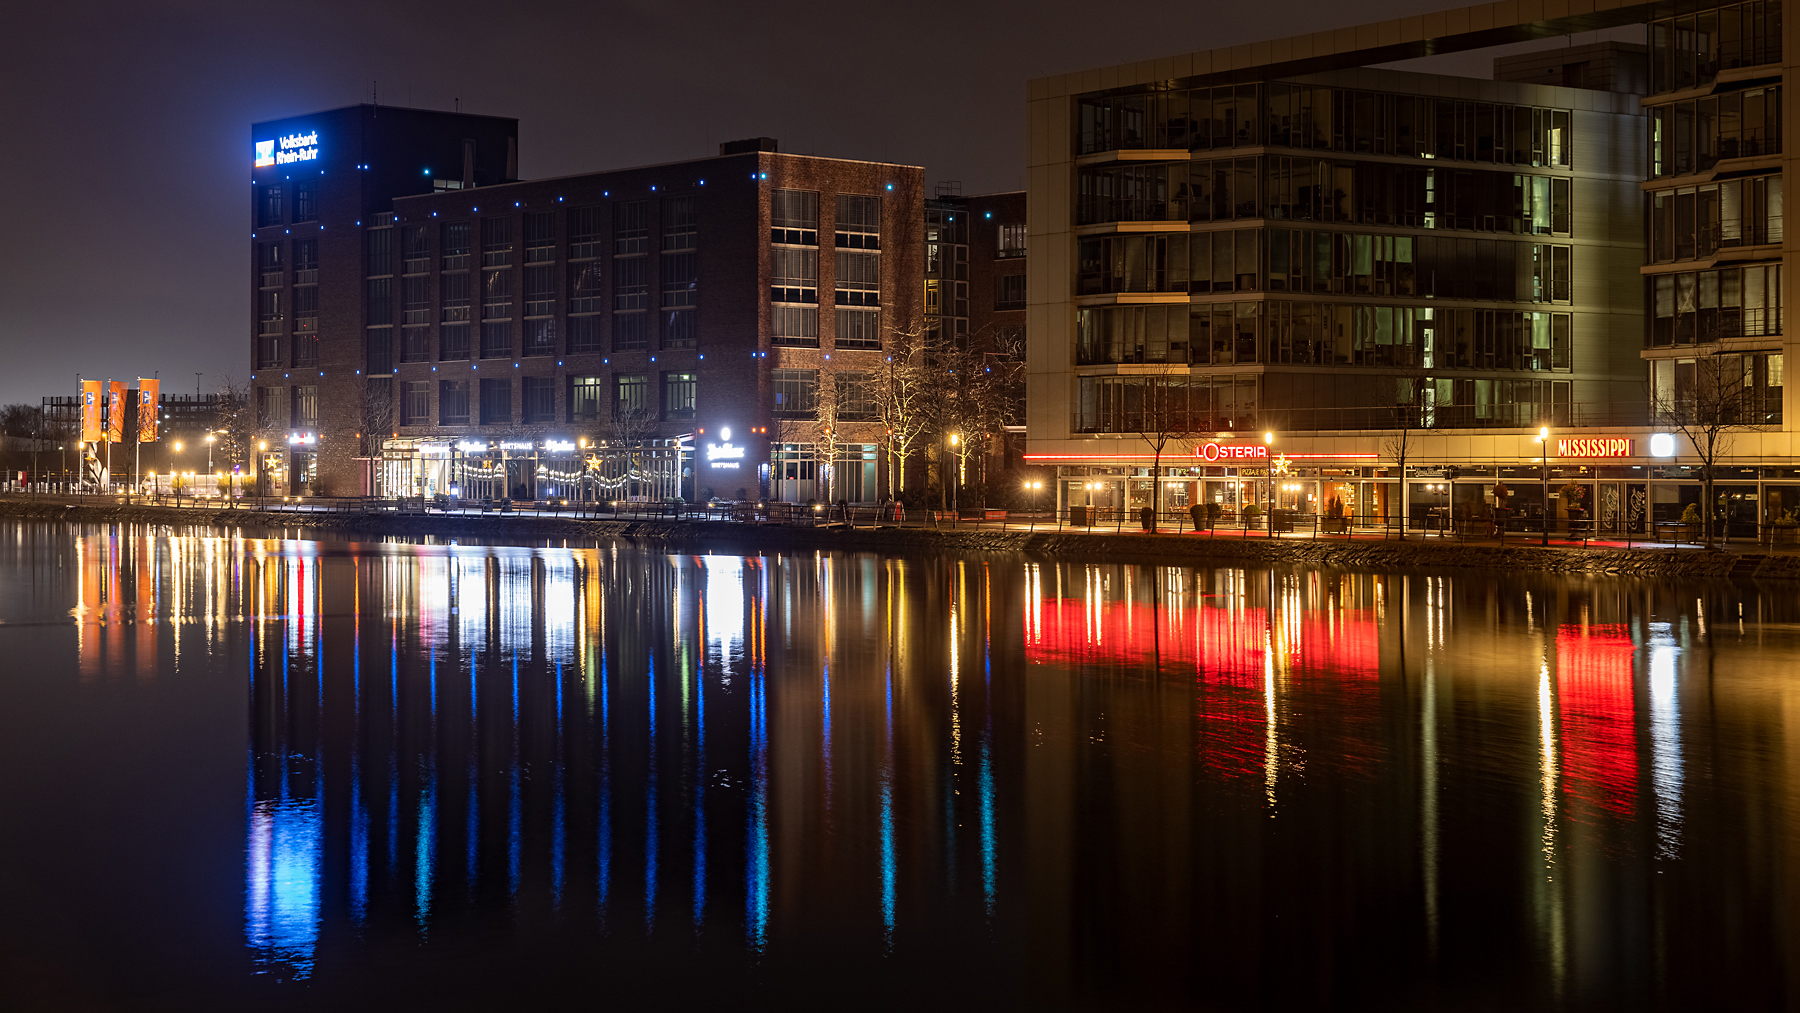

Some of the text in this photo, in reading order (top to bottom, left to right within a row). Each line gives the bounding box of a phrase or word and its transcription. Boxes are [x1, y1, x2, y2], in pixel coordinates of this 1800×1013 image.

[279, 131, 318, 149] Volksbank
[276, 146, 318, 164] Rhein-Ruhr
[500, 442, 533, 450] WIRTSHAUS
[1196, 443, 1267, 461] L'OSTERIA
[1557, 438, 1630, 457] MISSISSIPPI
[1241, 468, 1256, 476] PIZZA
